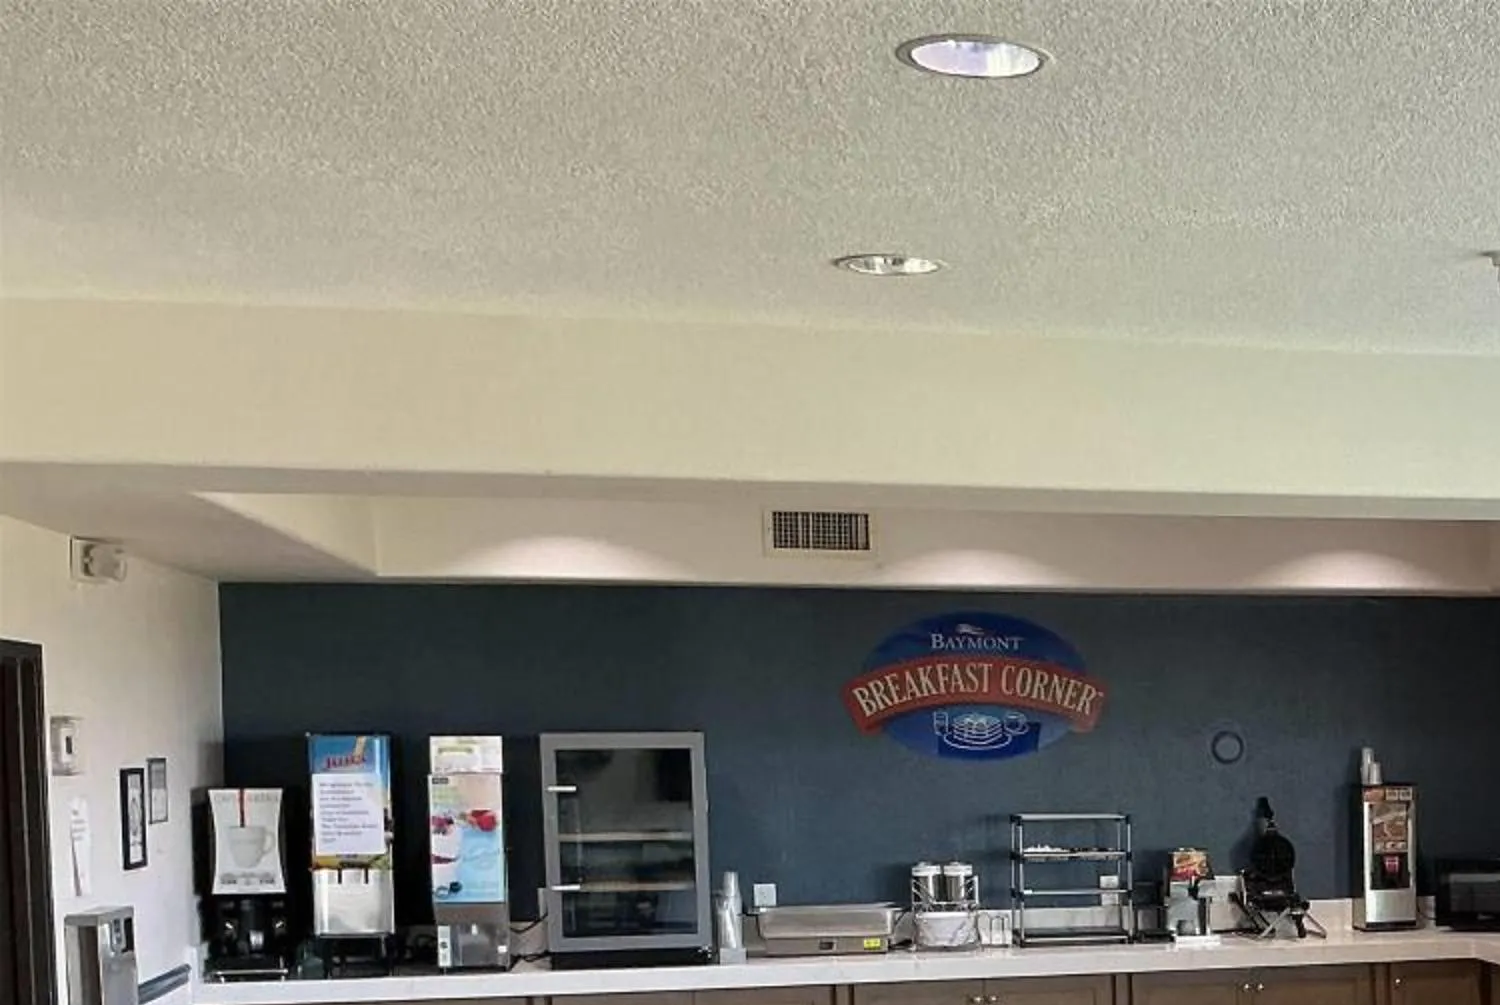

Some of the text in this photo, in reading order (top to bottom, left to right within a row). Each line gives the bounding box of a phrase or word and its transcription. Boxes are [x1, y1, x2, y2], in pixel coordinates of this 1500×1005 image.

[930, 633, 1024, 649] BAYMONT
[852, 663, 1097, 716] BREAKFAST CORNER
